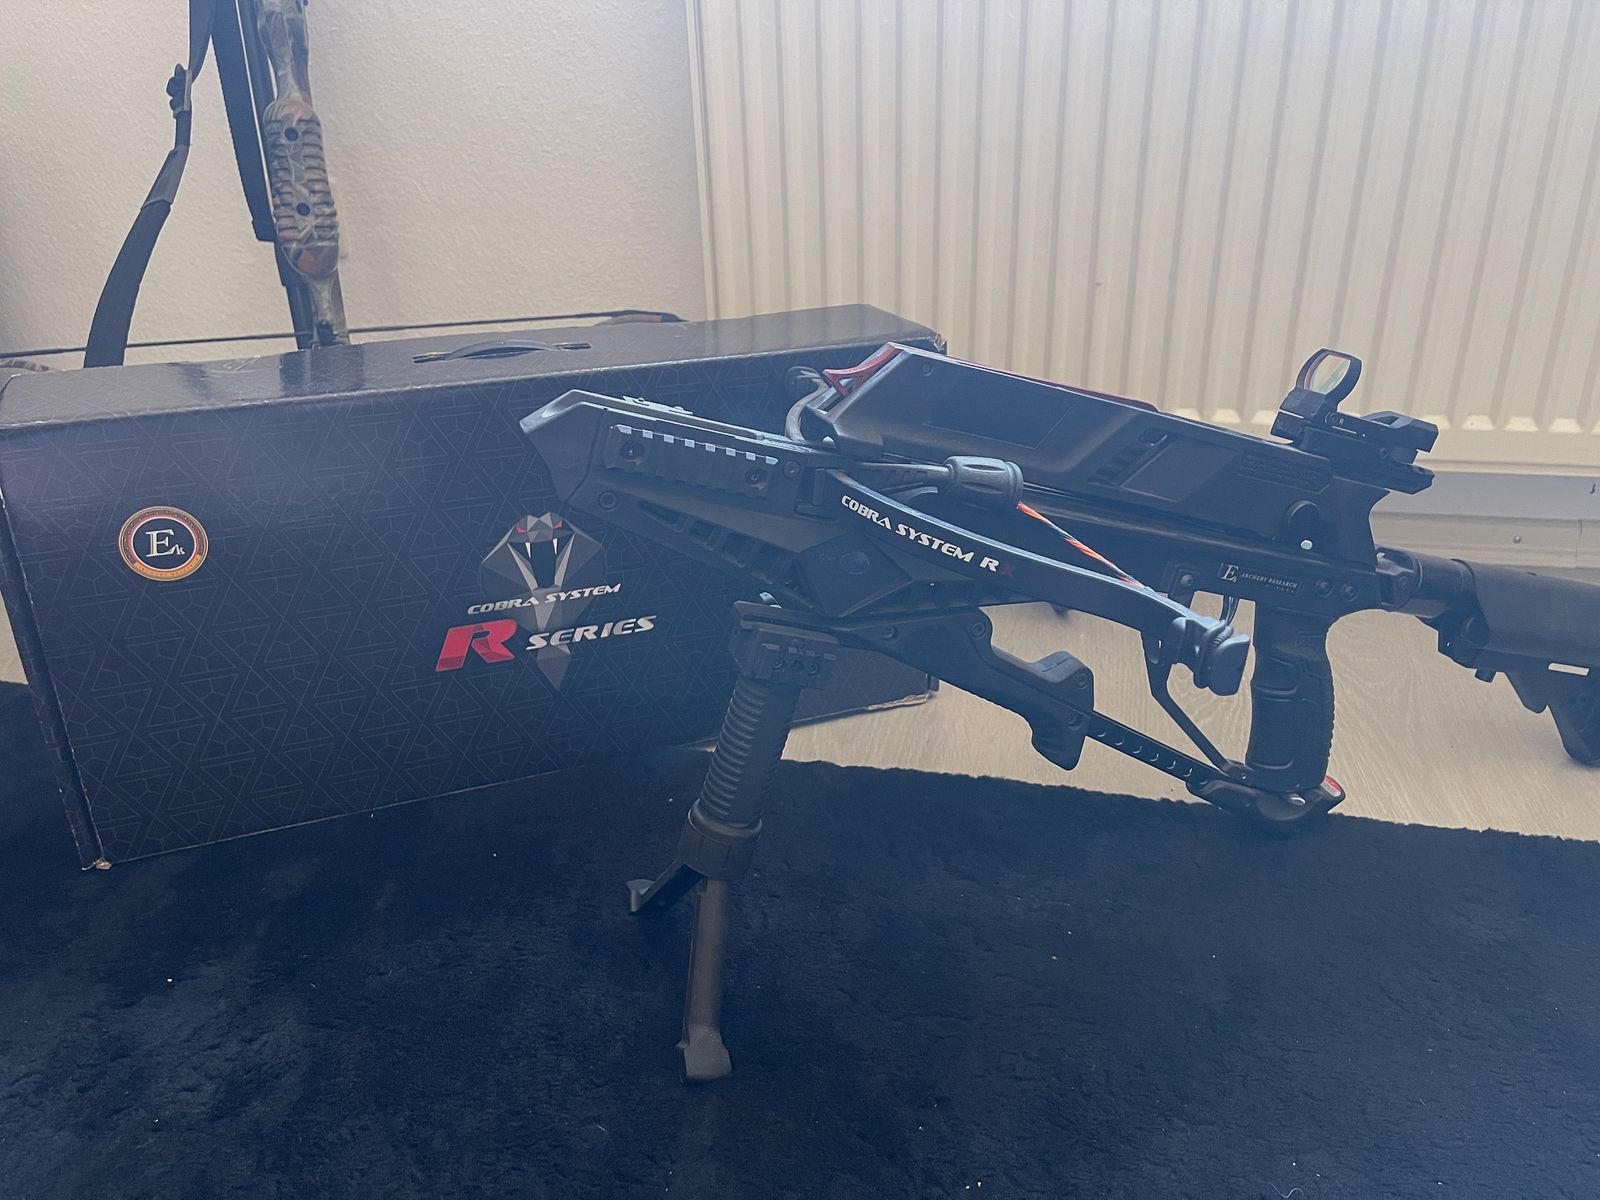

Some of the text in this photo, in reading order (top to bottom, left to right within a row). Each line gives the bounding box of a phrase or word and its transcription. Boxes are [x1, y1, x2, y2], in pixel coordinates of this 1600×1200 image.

[841, 494, 892, 530] COBRA
[895, 523, 975, 563] SYSTEM
[467, 583, 622, 615] COBRA SYSTEM
[1241, 572, 1267, 583] ARCHERY
[1267, 577, 1298, 589] RESEARCH
[435, 615, 657, 672] R SERIES
